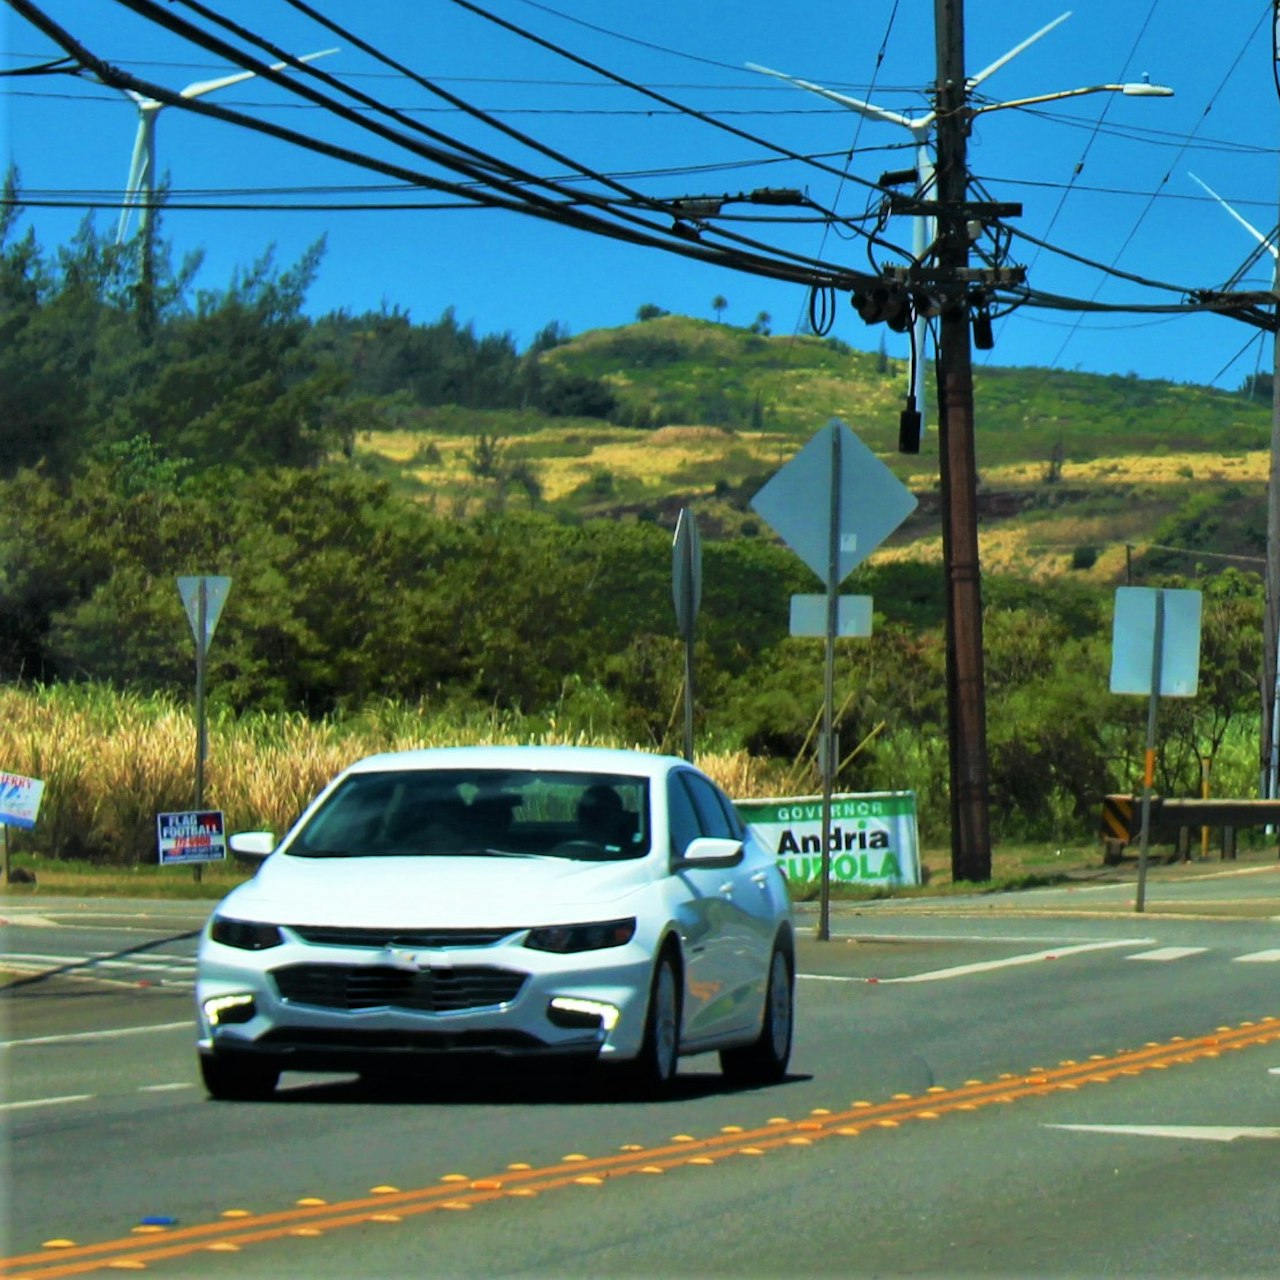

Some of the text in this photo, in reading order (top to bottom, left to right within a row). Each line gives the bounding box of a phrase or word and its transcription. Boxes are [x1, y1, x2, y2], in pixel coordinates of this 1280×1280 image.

[169, 814, 198, 826] FLAG
[163, 823, 219, 838] FOOTBALL
[777, 820, 889, 855] Andria
